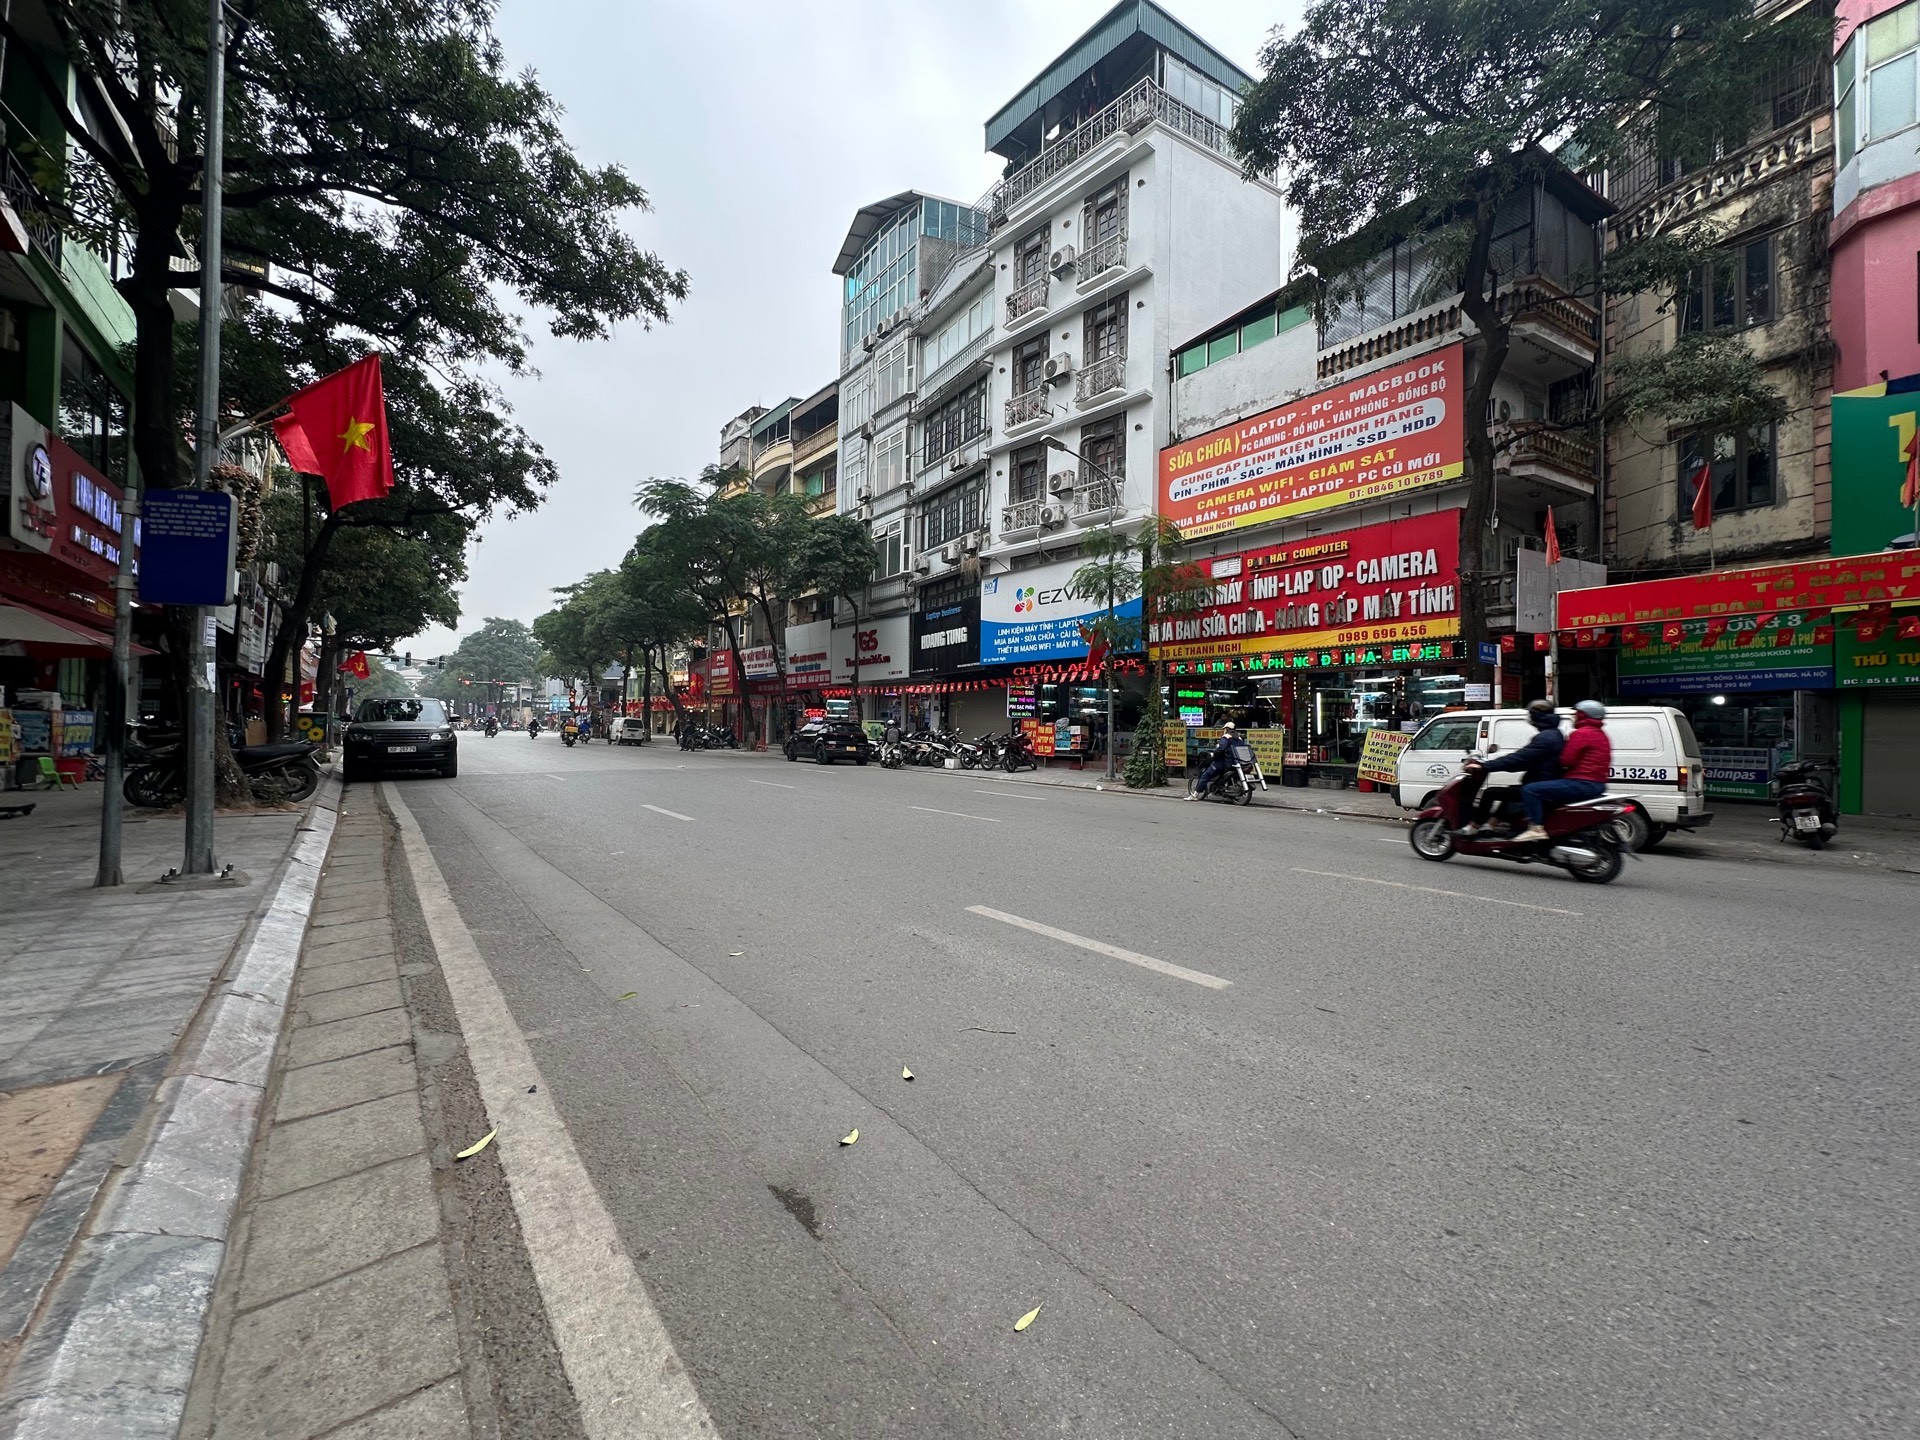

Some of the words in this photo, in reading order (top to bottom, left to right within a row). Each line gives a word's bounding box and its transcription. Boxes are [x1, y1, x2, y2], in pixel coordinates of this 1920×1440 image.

[1242, 412, 1297, 439] LAPTOP
[1312, 400, 1333, 416] PC
[1350, 360, 1446, 403] MACBOOK
[1242, 442, 1252, 454] PC
[1254, 431, 1286, 450] GAMING
[1307, 418, 1325, 432] HỌA
[1332, 409, 1352, 424] VĂN
[1354, 396, 1389, 418] PHÒNG
[1430, 376, 1447, 393] BỘ
[1168, 450, 1194, 472] SỬA
[1196, 438, 1232, 463] CHỮA
[1174, 488, 1192, 500] PIN
[1200, 476, 1230, 492] PHÍM
[1240, 466, 1264, 481] SẠC
[1275, 454, 1305, 470] MÀN
[1308, 442, 1343, 460] HÌNH
[1356, 430, 1387, 447] SSD
[1402, 416, 1436, 434] HDD
[1181, 470, 1212, 486] CUNG
[1216, 461, 1241, 476] CẤP
[1244, 450, 1276, 468] LINH
[1280, 439, 1314, 456] KIỆN
[1318, 422, 1369, 444] CHÍNH
[1196, 487, 1255, 511] CAMERA
[1258, 476, 1294, 494] WIFI
[1308, 460, 1355, 480] GIÁM
[1360, 448, 1397, 467] SÁT
[1196, 510, 1218, 524] BÁN
[1228, 500, 1257, 516] TRAO
[1292, 478, 1344, 503] LAPTOP
[1357, 468, 1378, 483] PC
[1382, 460, 1403, 476] CŨ
[1407, 452, 1440, 471] MỚI
[1190, 524, 1214, 536] THANH
[1367, 481, 1394, 495] 0846
[1398, 478, 1410, 488] 10
[1414, 469, 1444, 484] 6789
[1293, 540, 1349, 560] COMPUTER
[1216, 578, 1243, 606] MÁY
[1356, 548, 1438, 585] CAMERA
[1809, 569, 1886, 588] DÂN
[1202, 609, 1228, 638] SỬA
[1229, 606, 1266, 635] CHỮA
[1274, 601, 1320, 630] NÂNG
[1324, 590, 1358, 626] CẤP
[1363, 588, 1403, 621] MÁY
[1408, 582, 1456, 616] TÍNH
[1569, 612, 1626, 626] TOÀN
[1634, 607, 1682, 620] DÂN
[1694, 598, 1764, 616] ĐOÀN
[1776, 592, 1828, 608] KẾT
[1787, 614, 1802, 627] 3
[994, 638, 1007, 646] MUA
[1008, 635, 1020, 645] BÁN
[1024, 633, 1037, 642] SỬA
[1038, 631, 1056, 642] CHỮA
[1060, 628, 1071, 639] CÀI
[998, 628, 1010, 636] LINH
[1024, 624, 1038, 633] MÁY
[1040, 622, 1054, 632] TÍNH
[1058, 619, 1084, 629] LAPTOP
[1173, 646, 1183, 657] LÊ
[1185, 646, 1215, 656] THANH
[1338, 630, 1369, 643] 0989
[1372, 628, 1397, 639] 696
[1402, 624, 1427, 637] 456
[1038, 642, 1052, 651] WIFI
[1056, 640, 1070, 650] MÁY
[1071, 640, 1078, 648] IN
[1852, 650, 1888, 667] THỦ
[1014, 662, 1054, 676] CHỮA
[1126, 658, 1140, 668] PC
[1884, 676, 1900, 684] LÊ
[1368, 741, 1393, 750] LAPTOP
[1370, 731, 1387, 741] THU
[1389, 734, 1408, 744] MUA
